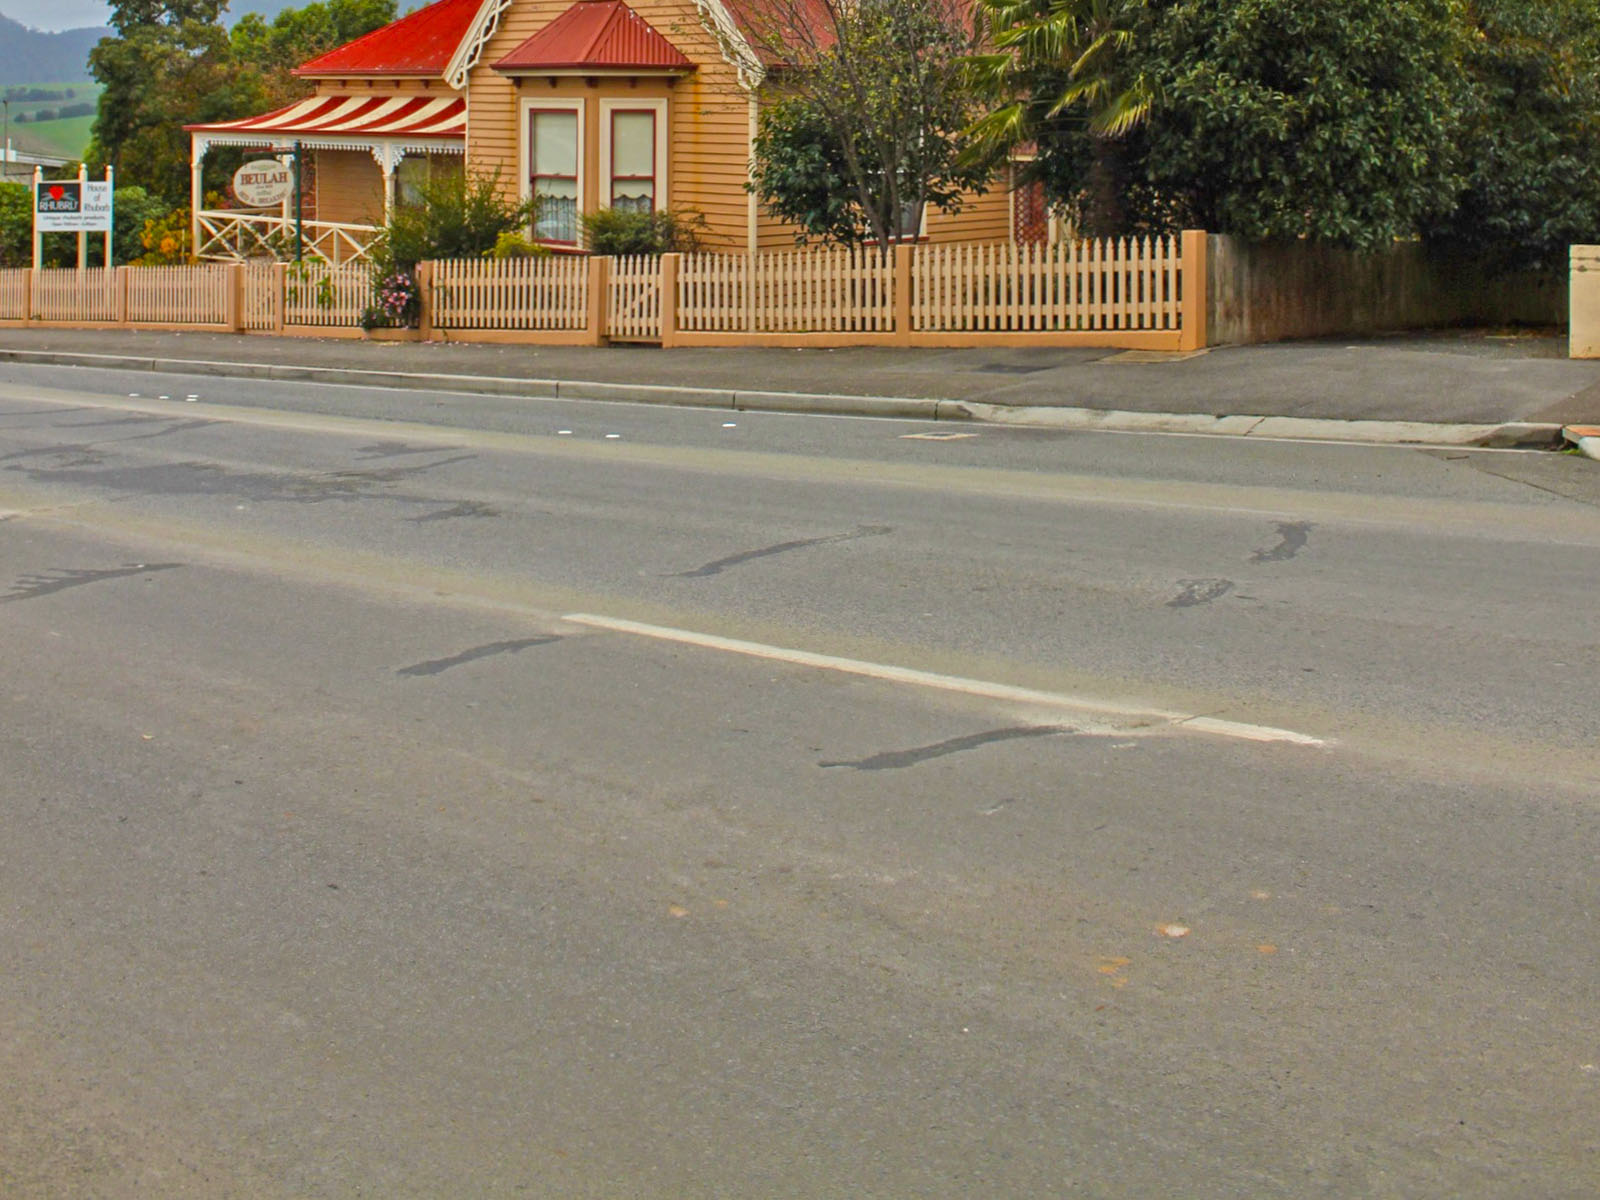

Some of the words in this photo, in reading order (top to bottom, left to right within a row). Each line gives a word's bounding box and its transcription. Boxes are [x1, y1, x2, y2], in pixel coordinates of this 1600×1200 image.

[240, 172, 288, 185] BEULAH
[87, 184, 107, 192] House
[93, 193, 101, 202] of
[84, 203, 110, 212] Rhubarb
